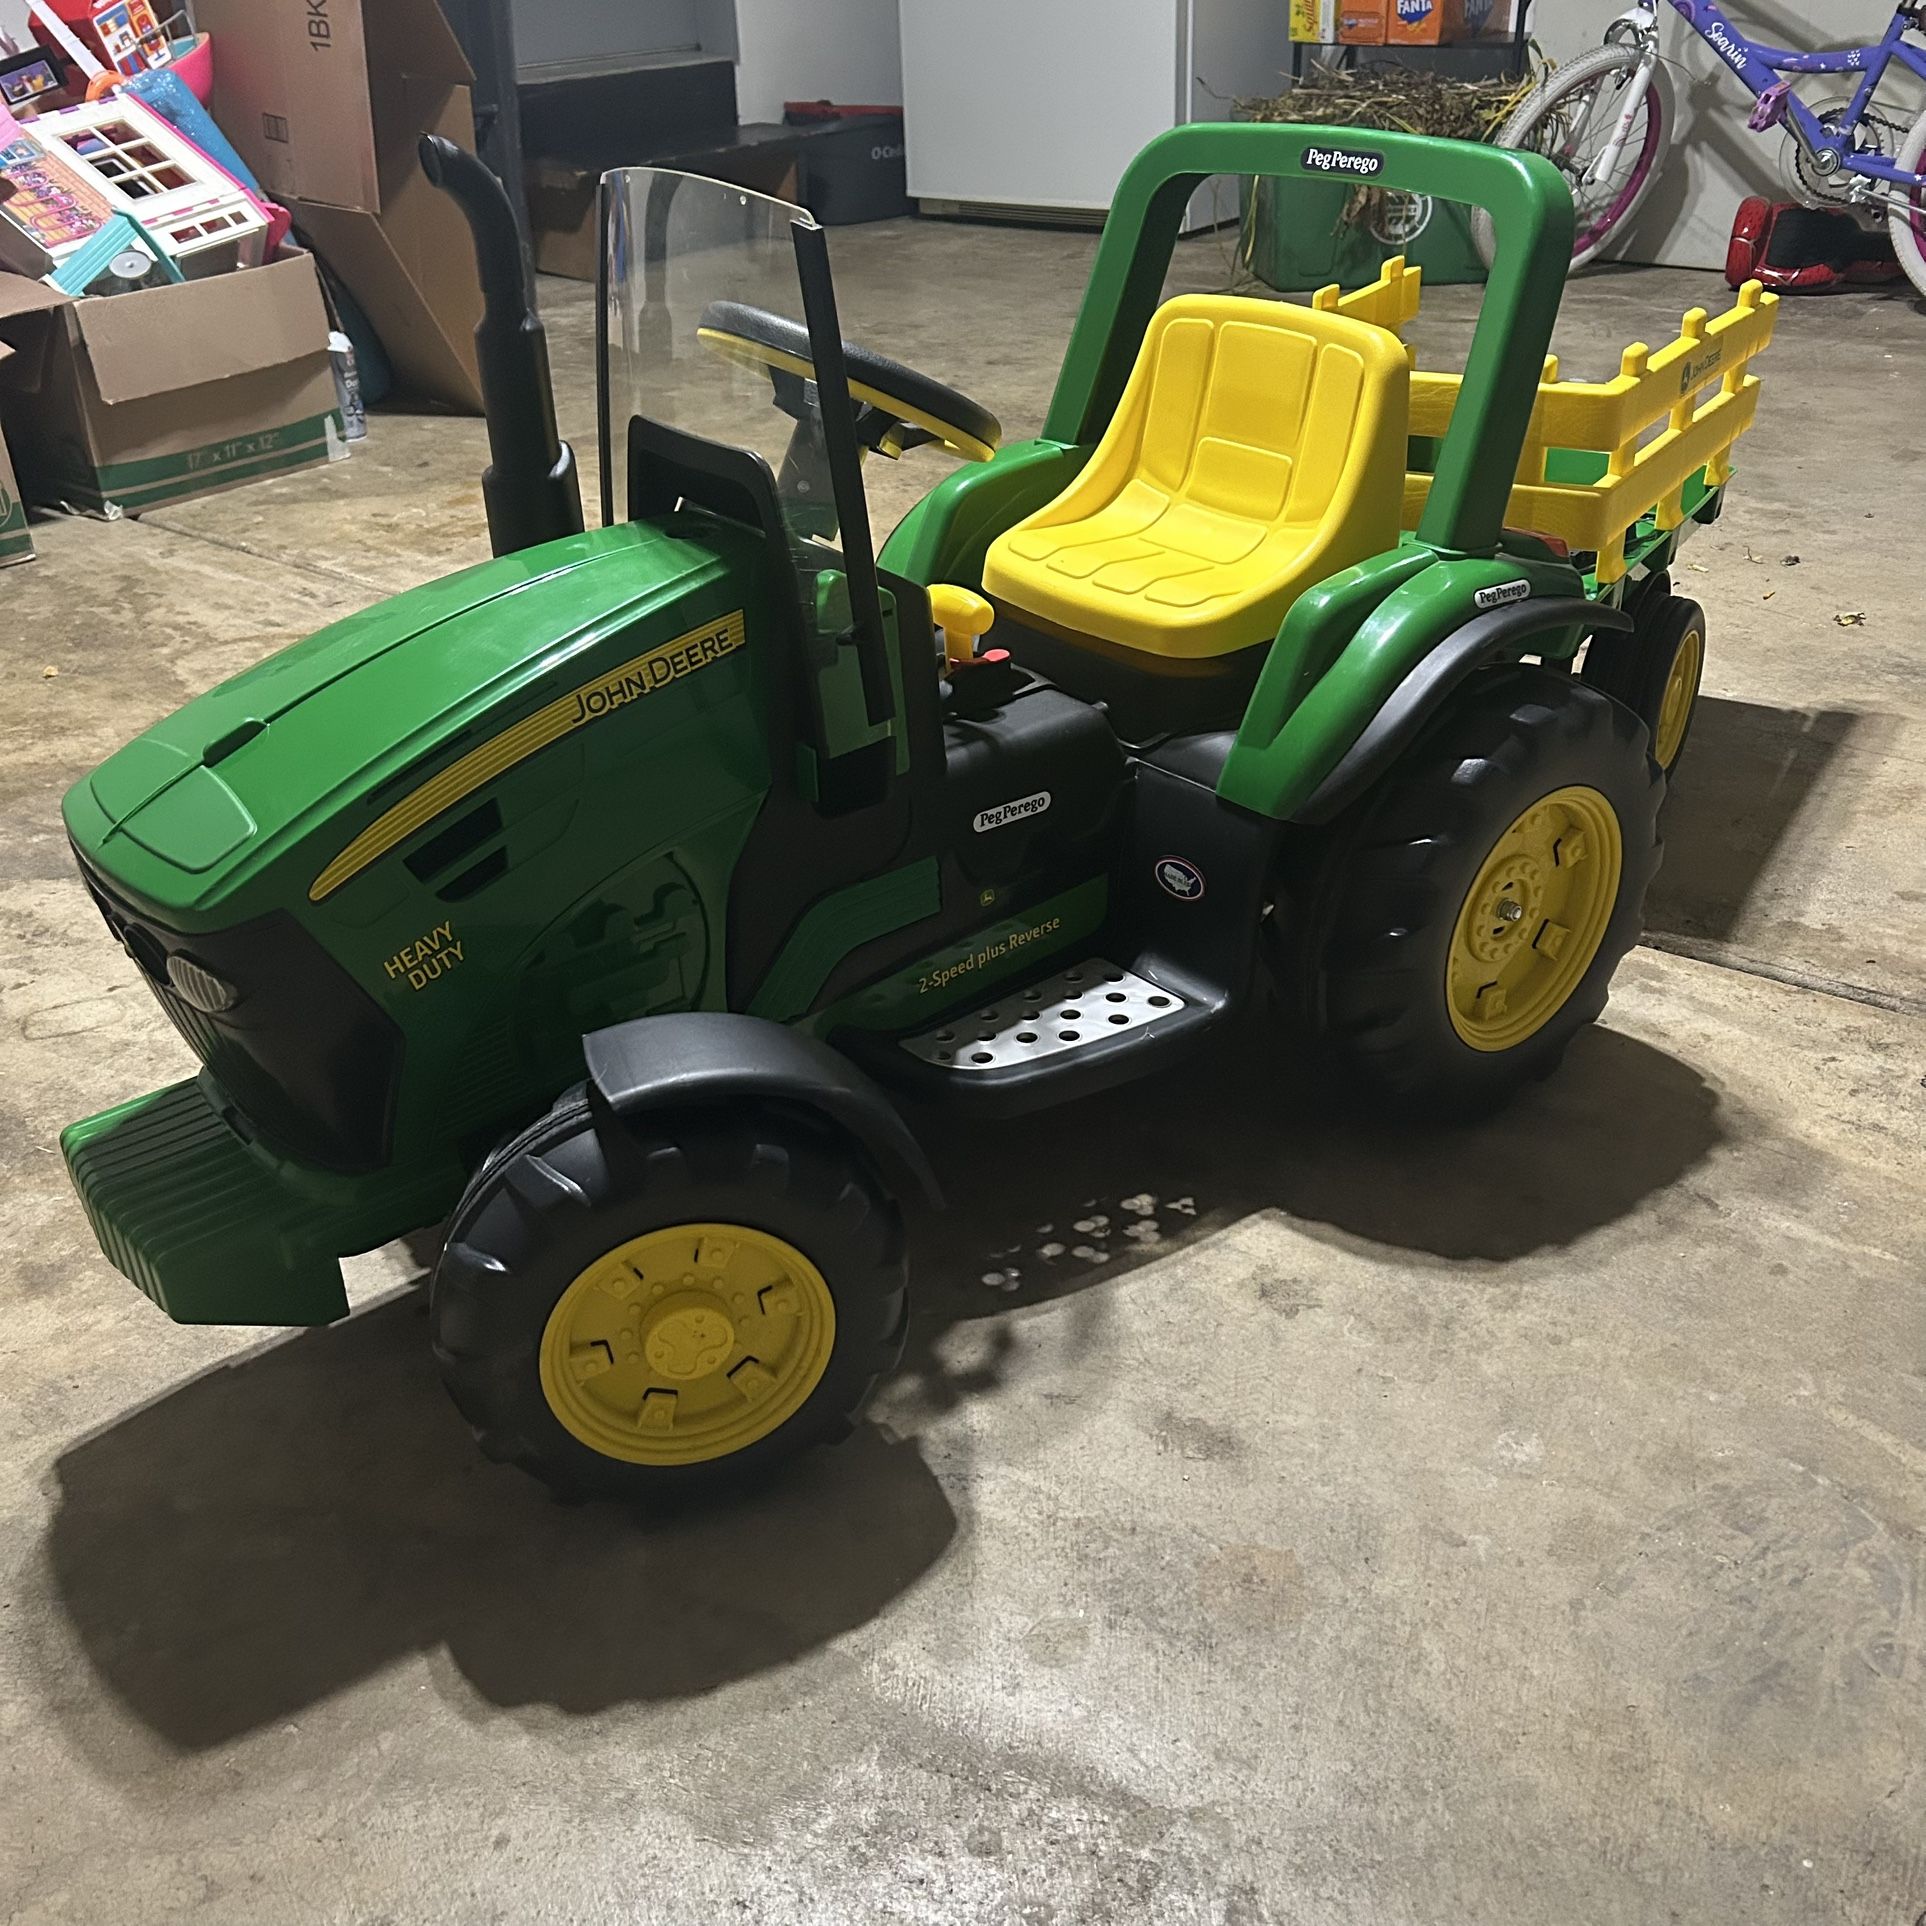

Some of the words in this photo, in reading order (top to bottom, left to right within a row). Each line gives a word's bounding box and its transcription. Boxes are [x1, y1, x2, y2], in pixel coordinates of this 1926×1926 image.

[1306, 148, 1378, 174] PegPerego
[1479, 584, 1527, 604] PegPerego
[571, 671, 647, 724] JOHN
[647, 628, 733, 685] DEERE
[980, 797, 1045, 827] PegPerego
[383, 920, 453, 979] HEAVY
[407, 940, 464, 991] DUTY
[918, 953, 975, 993] 2-Speed
[977, 941, 1006, 969] plus
[1008, 917, 1061, 950] Reverse
